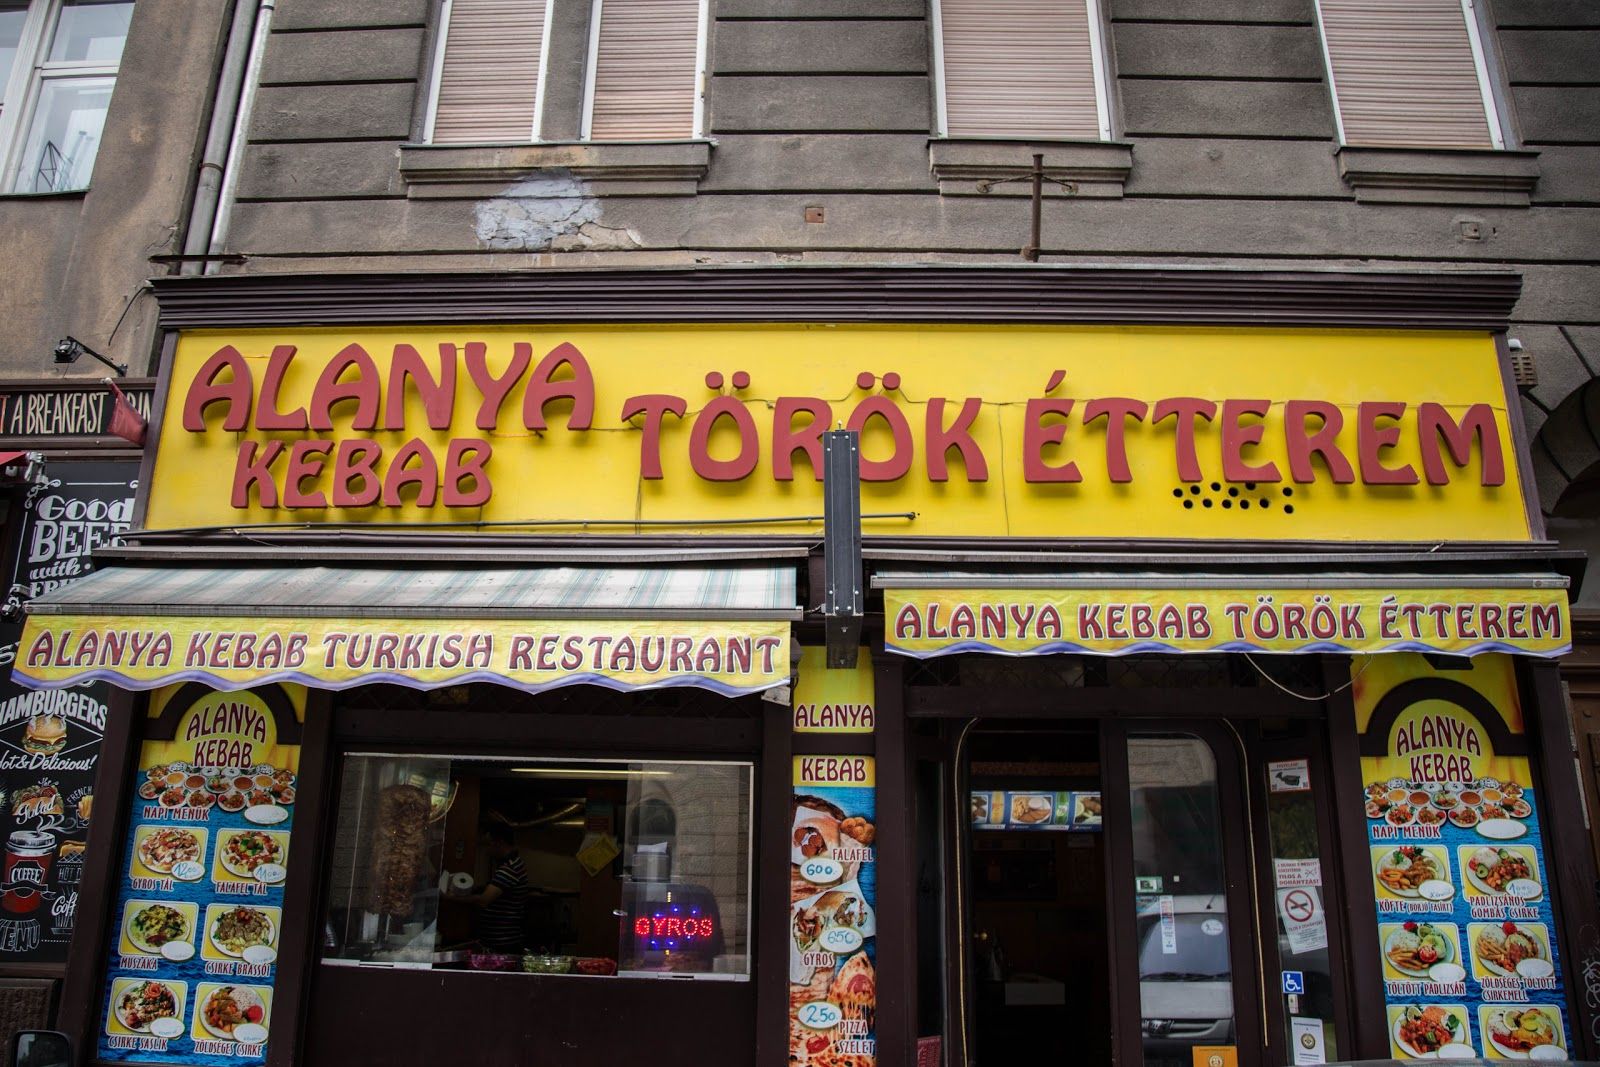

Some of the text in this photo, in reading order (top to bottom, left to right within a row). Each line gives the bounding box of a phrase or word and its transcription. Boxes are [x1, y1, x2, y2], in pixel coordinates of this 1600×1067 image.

[182, 342, 595, 431] ALANYA
[10, 394, 23, 434] A
[26, 392, 109, 434] BREAKFAST
[622, 370, 1506, 487] TÖRÖK ÉTTEREM
[230, 439, 493, 508] KEBAB
[35, 495, 136, 521] Good
[30, 558, 82, 580] with
[895, 595, 1562, 640] ALANYA KEBAB TÖRÖK ÉTTEREM
[26, 630, 172, 668] ALANYA
[185, 632, 307, 669] KEBAB
[322, 633, 494, 670] TURKISH
[509, 635, 782, 675] RESTAURANT
[187, 702, 267, 744] ALANYA
[795, 704, 874, 728] ALANYA
[1396, 716, 1481, 756] ALANYA
[194, 739, 253, 769] KEBAB
[802, 757, 866, 782] KEBAB
[1410, 753, 1474, 783] KEBAB
[143, 806, 210, 821] NAPI MENÜK
[1373, 824, 1440, 838] NAPI MENÜK
[833, 848, 873, 861] FALAFEL
[11, 867, 43, 884] COFFEE
[132, 879, 174, 891] GYROS TÁL
[216, 882, 267, 895] FALAFEL TÁL
[1379, 900, 1404, 912] KÖFTE
[1470, 894, 1525, 906] PADLIZSÁNOS
[1472, 906, 1538, 918] GOMBÁS CSIRKE
[635, 917, 713, 937] GYROS
[120, 957, 158, 970] MUSZAKA
[804, 953, 834, 966] GYROS
[205, 961, 271, 976] CSIRKE BRASSÓI
[1387, 981, 1465, 994] TÖLTÖTT PADLIZSÁN
[1481, 976, 1521, 988] ZÖLDSÉGES
[1482, 989, 1528, 1001] CSIRKEMELL
[839, 1021, 868, 1034] PIZZA
[108, 1036, 168, 1051] CSIRKE SASLIK
[195, 1040, 263, 1057] ZÖLDSÉGES CSIRKE
[838, 1041, 874, 1054] SZELET
